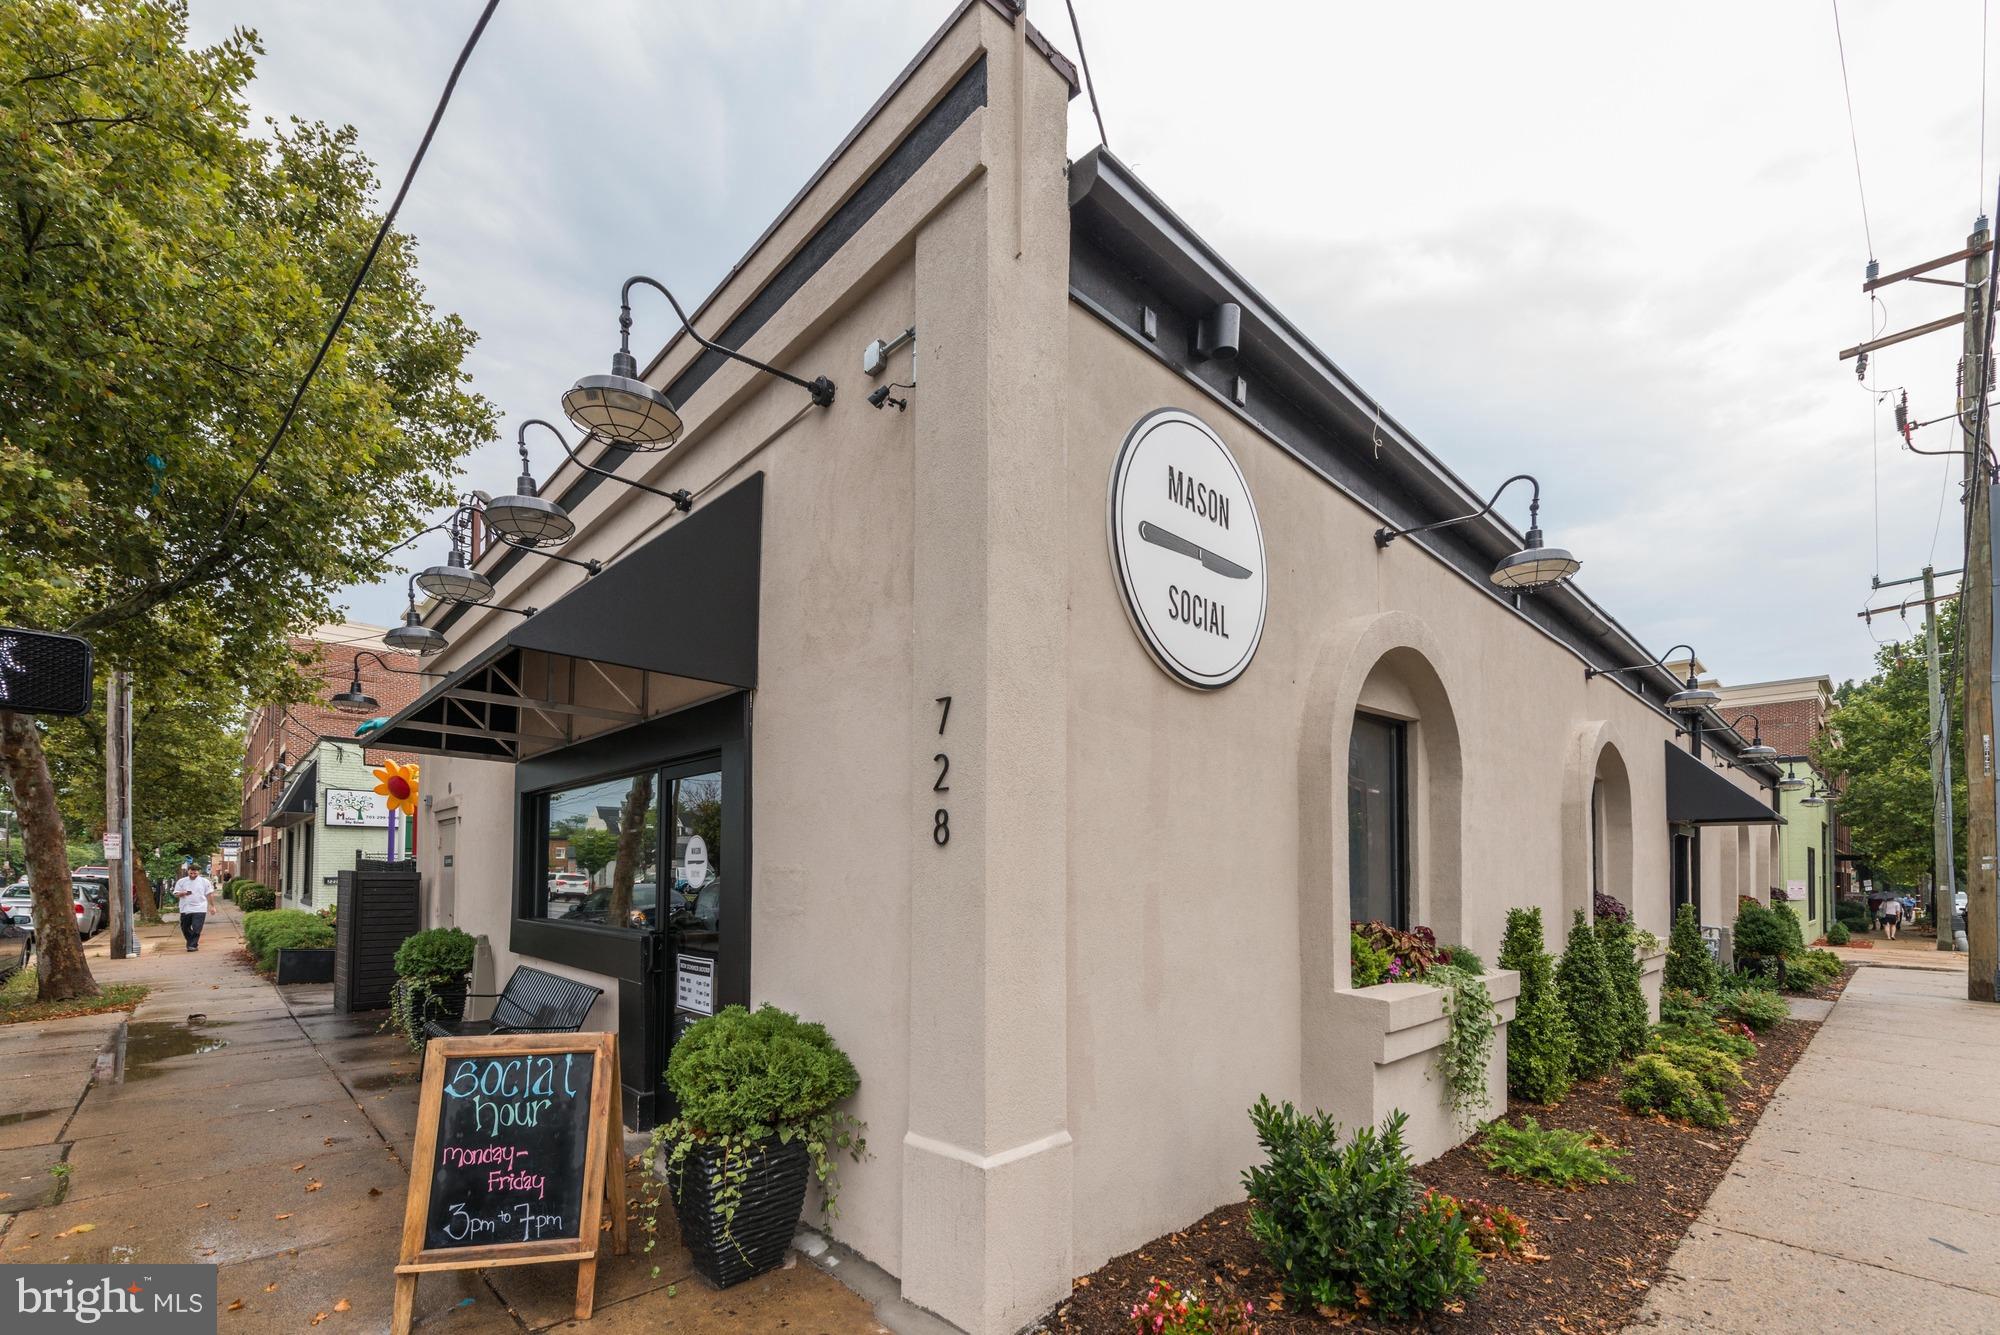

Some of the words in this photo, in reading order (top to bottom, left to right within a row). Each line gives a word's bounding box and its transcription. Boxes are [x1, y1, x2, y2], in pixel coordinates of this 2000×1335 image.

[1168, 465, 1229, 530] MASON
[1168, 584, 1229, 639] SOCIAL
[472, 1095, 552, 1137] hour
[487, 1170, 545, 1199] Friday
[443, 1202, 495, 1240] 3pm
[498, 1210, 511, 1223] to
